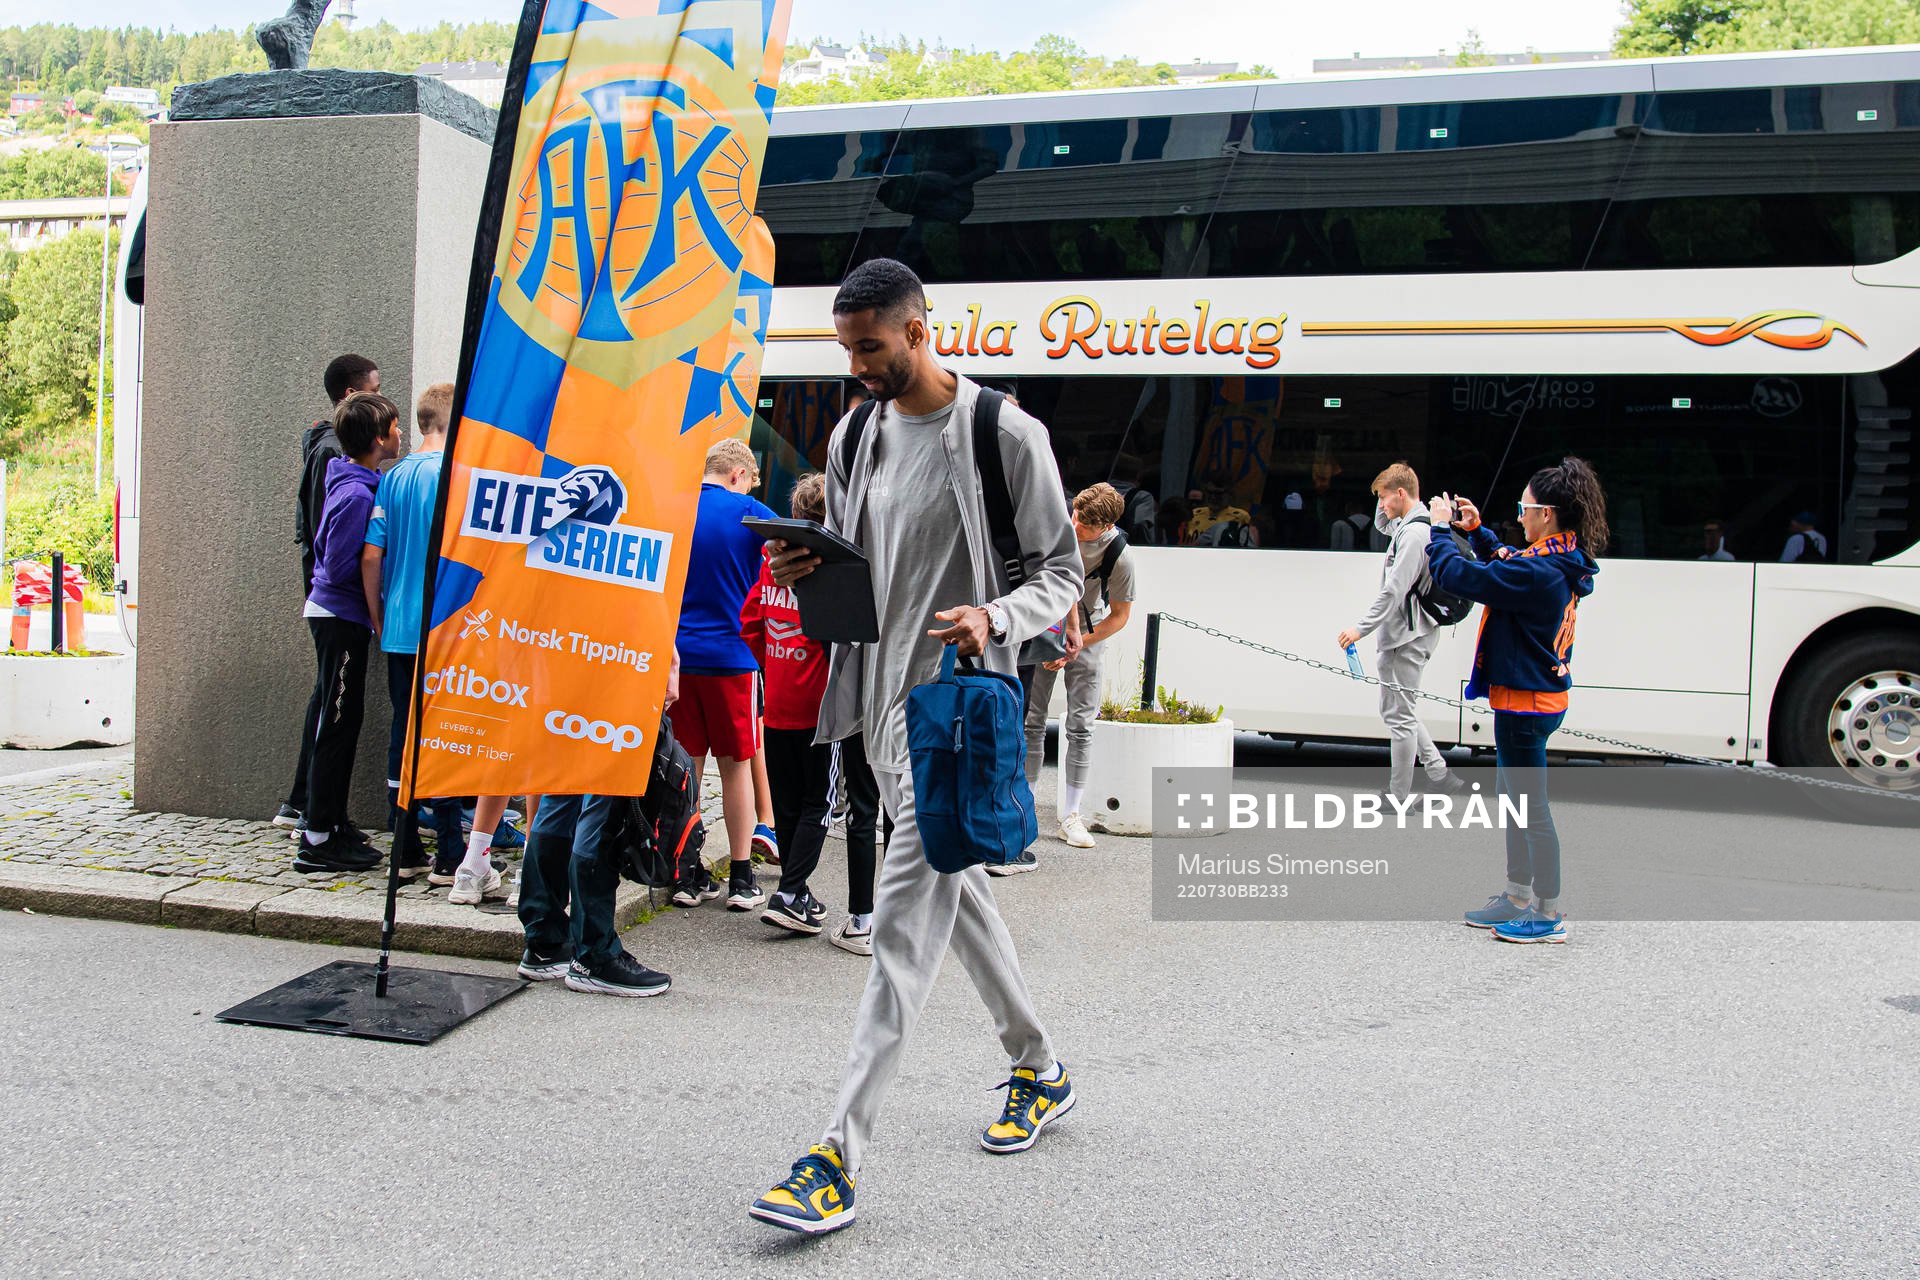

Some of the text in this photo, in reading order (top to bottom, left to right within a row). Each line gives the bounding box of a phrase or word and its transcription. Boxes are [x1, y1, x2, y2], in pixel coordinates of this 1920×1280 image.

[926, 294, 1288, 369] ula Rutelag
[469, 478, 556, 537] ELTE
[543, 521, 663, 582] SERIEN
[498, 618, 653, 673] Norsk Tipping
[766, 641, 807, 661] mbro
[420, 736, 515, 761] rdvest Fiber
[440, 721, 487, 737] LEVERES AV
[544, 710, 644, 753] coop
